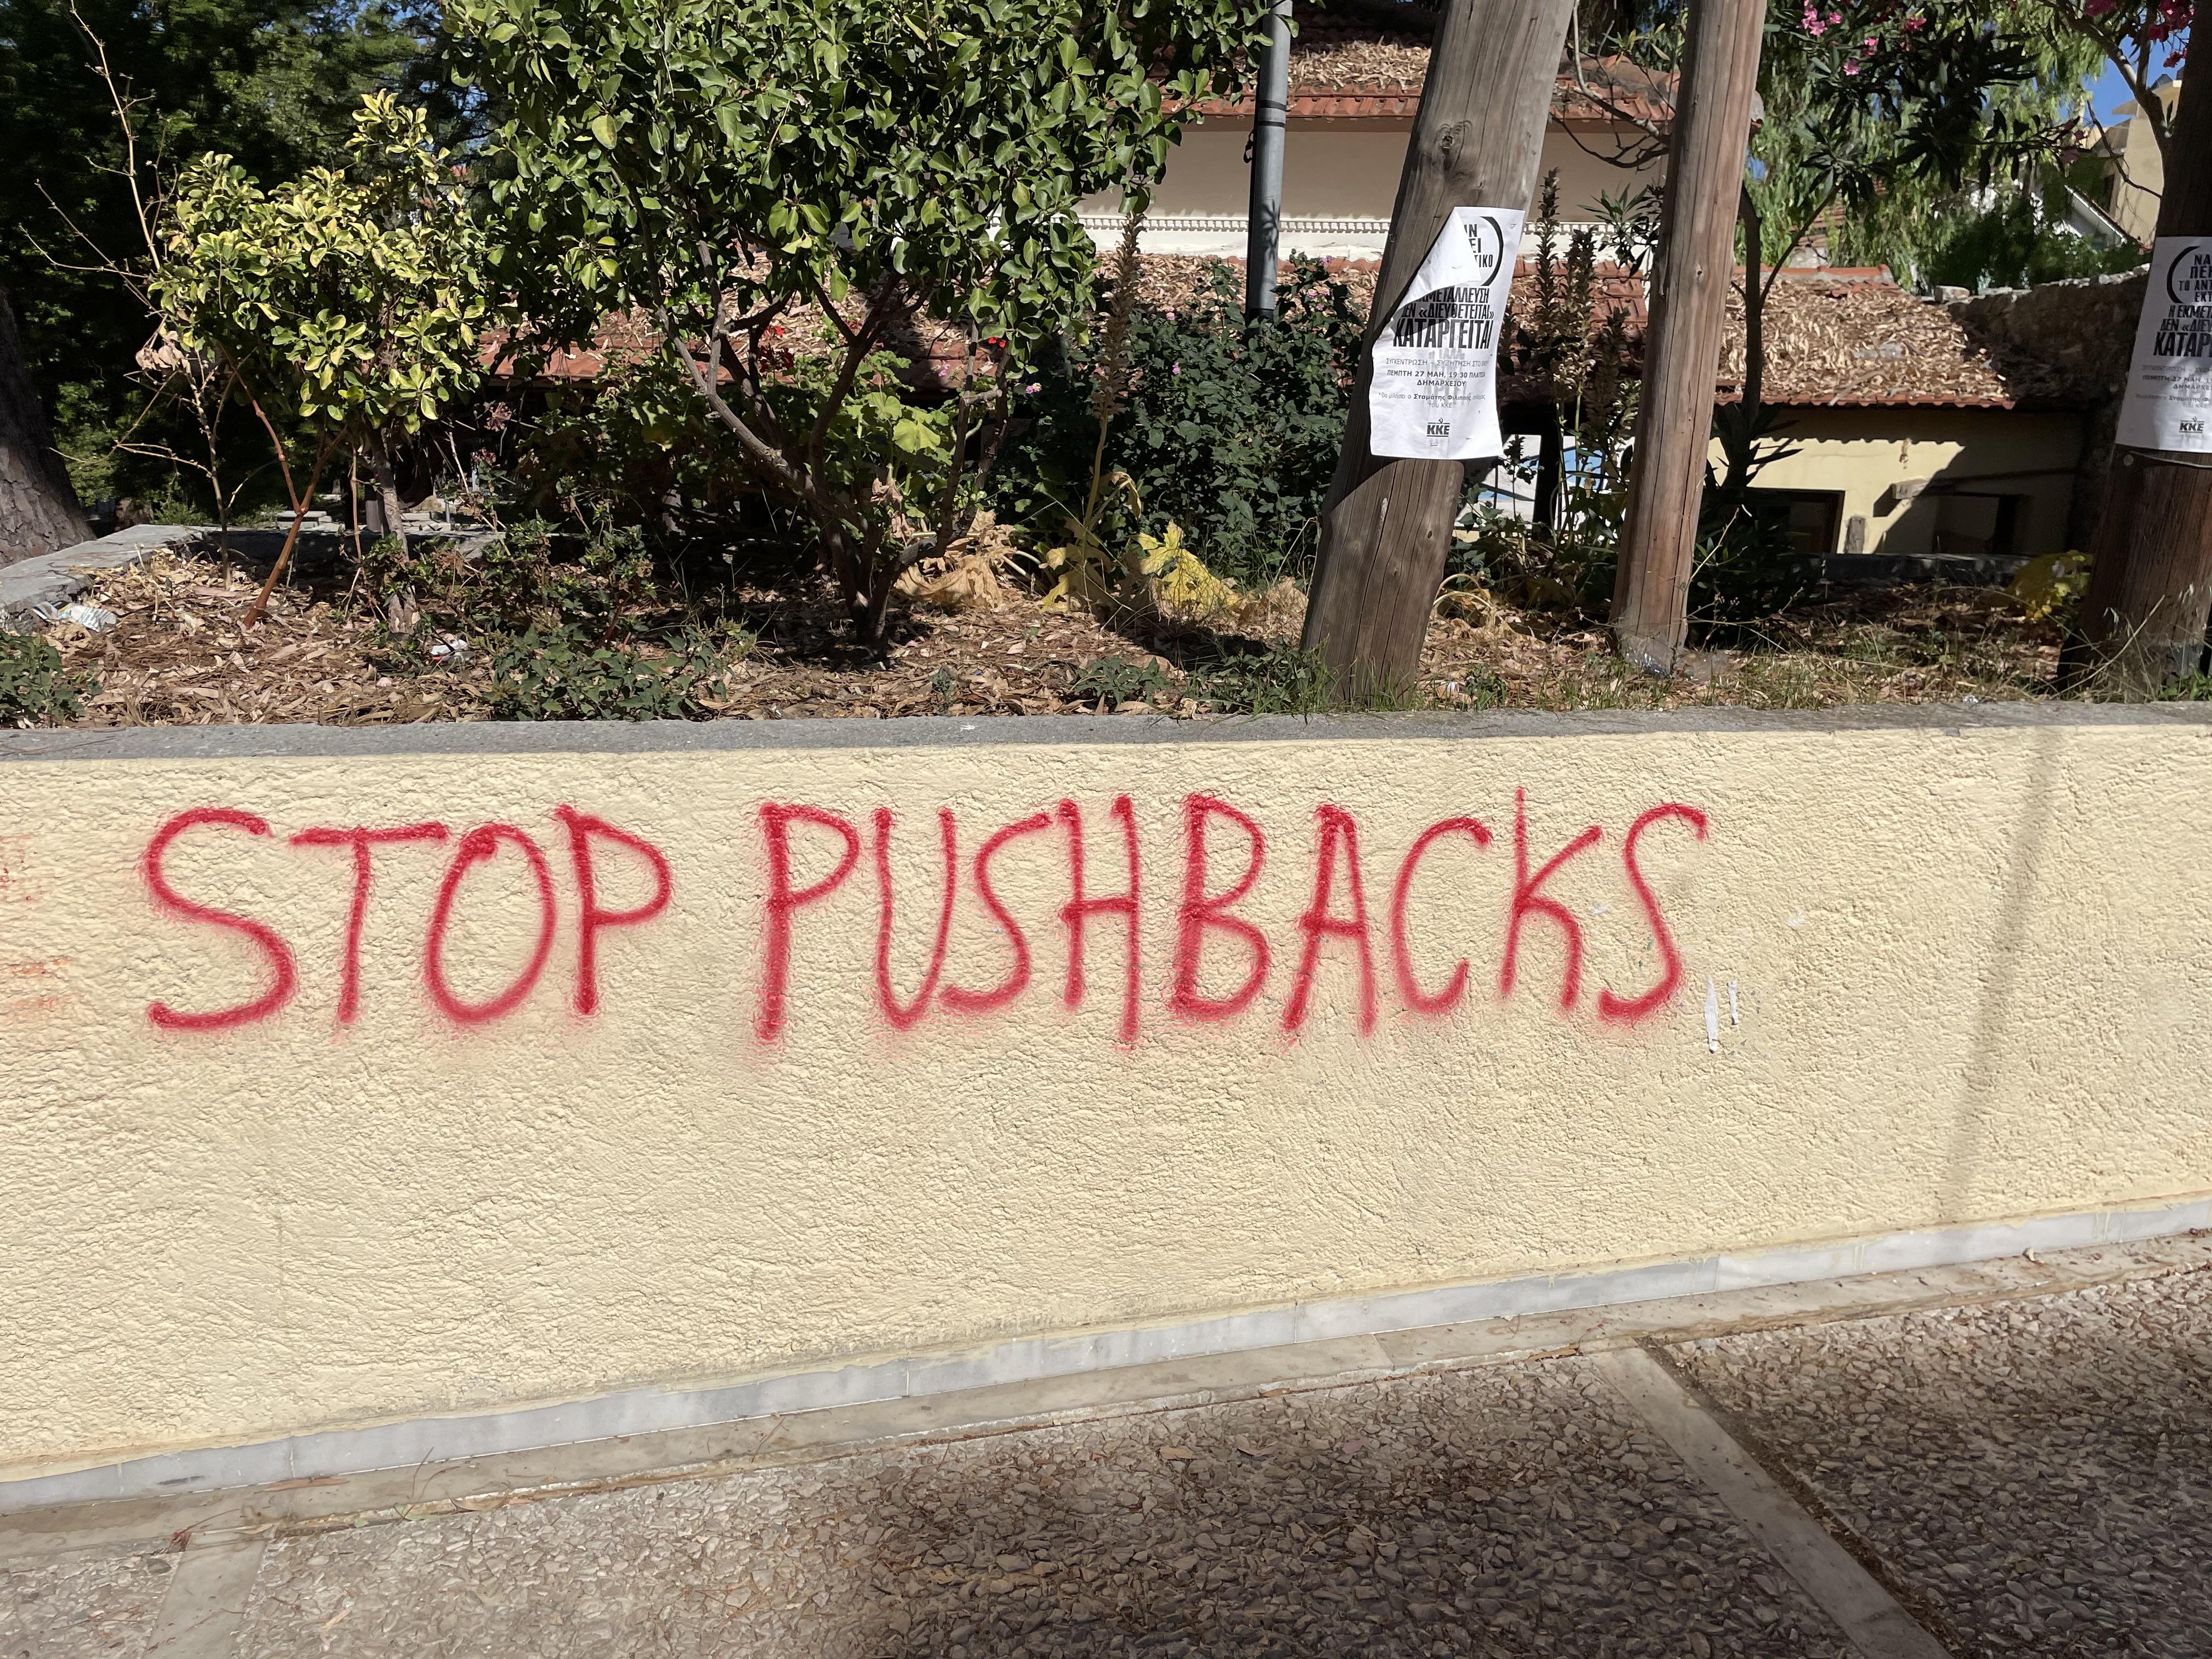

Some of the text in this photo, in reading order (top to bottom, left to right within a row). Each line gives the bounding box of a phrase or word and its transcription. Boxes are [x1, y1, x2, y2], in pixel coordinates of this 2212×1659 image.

[1392, 318, 1494, 349] ΚΑΤΑΡΓΕΙΤΑΙ
[2153, 332, 2212, 357] ΚΑΤΑΡ
[1427, 424, 1450, 435] ΚΚΕ
[2179, 422, 2204, 431] ΚΚΕ
[142, 788, 1708, 1046] STOP PUSHBACKS
